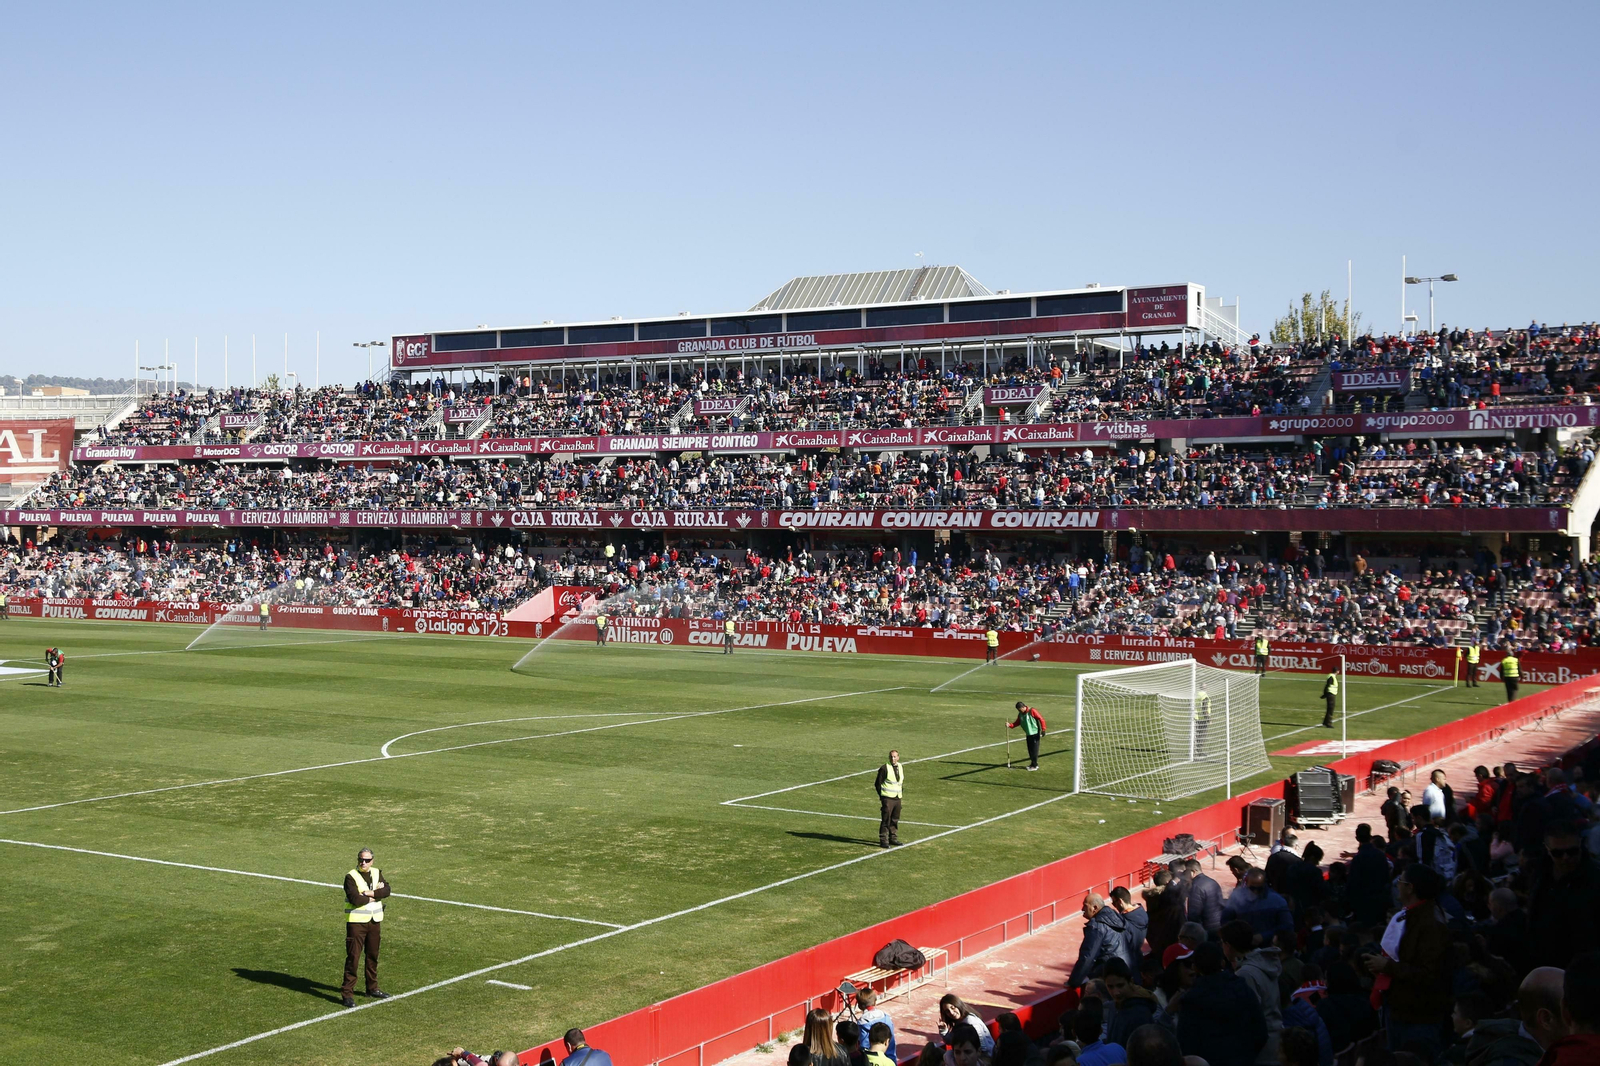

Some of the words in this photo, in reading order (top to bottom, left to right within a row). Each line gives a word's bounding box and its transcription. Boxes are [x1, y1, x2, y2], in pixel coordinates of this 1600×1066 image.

[1142, 312, 1176, 320] GRANADA
[406, 342, 428, 357] GCF
[677, 339, 726, 352] GRANADA
[728, 337, 756, 350] CLUB
[759, 336, 774, 348] DE
[1341, 371, 1402, 386] IDEAL
[991, 387, 1039, 400] IDEAL
[1280, 417, 1354, 432] grupo2000
[1377, 414, 1455, 429] grupo2000
[1491, 412, 1578, 428] NEPTUNO
[1018, 427, 1074, 440] CaixaBank
[1106, 421, 1148, 434] vithas
[609, 437, 659, 450] GRANADA
[661, 436, 709, 449] SIEMPRE
[712, 434, 758, 448] CONTIGO
[789, 434, 838, 446] CaixaBank
[862, 432, 914, 444] CaixaBank
[938, 430, 992, 442] CaixaBank
[263, 444, 298, 455] CASTOR
[320, 443, 355, 454] CASTOR
[372, 444, 412, 455] CaixaBank
[430, 442, 472, 454] CaixaBank
[490, 441, 532, 452] CaixaBank
[551, 439, 595, 451] CaixaBank
[85, 447, 118, 458] Granada
[119, 447, 136, 460] Hoy
[203, 447, 240, 456] MotorDOS
[18, 512, 51, 522] PULEVA
[59, 512, 92, 522] PULEVA
[100, 512, 134, 522] PULEVA
[143, 512, 177, 522] PULEVA
[185, 512, 220, 522] PULEVA
[241, 512, 280, 524] CERVEZAS
[283, 512, 329, 524] ALHAMBRA
[357, 512, 398, 524] CERVEZAS
[401, 512, 449, 524] ALHAMBRA
[511, 512, 546, 526] CAJA
[551, 512, 602, 526] RURAL
[631, 512, 668, 526] CAJA
[673, 512, 728, 526] RURAL
[779, 512, 875, 527] COVIRAN
[880, 512, 983, 527] COVIRAN
[990, 512, 1100, 527] COVIRAN
[9, 605, 32, 615] RURAL
[42, 604, 84, 618] PULEVA
[95, 608, 147, 620] COVIRAN
[332, 607, 358, 616] GRUPO
[358, 608, 379, 616] LUNA
[166, 610, 208, 624] CaixaBank
[615, 617, 660, 628] CHIKITO
[428, 619, 465, 635] LaLiga
[605, 626, 658, 644] Allianz
[786, 632, 857, 653] PULEVA
[1164, 637, 1195, 648] Mata
[1104, 649, 1144, 662] CERVEZAS
[1350, 646, 1393, 657] HOLMES
[1395, 648, 1429, 658] PLACE
[1268, 655, 1322, 670] RURAL
